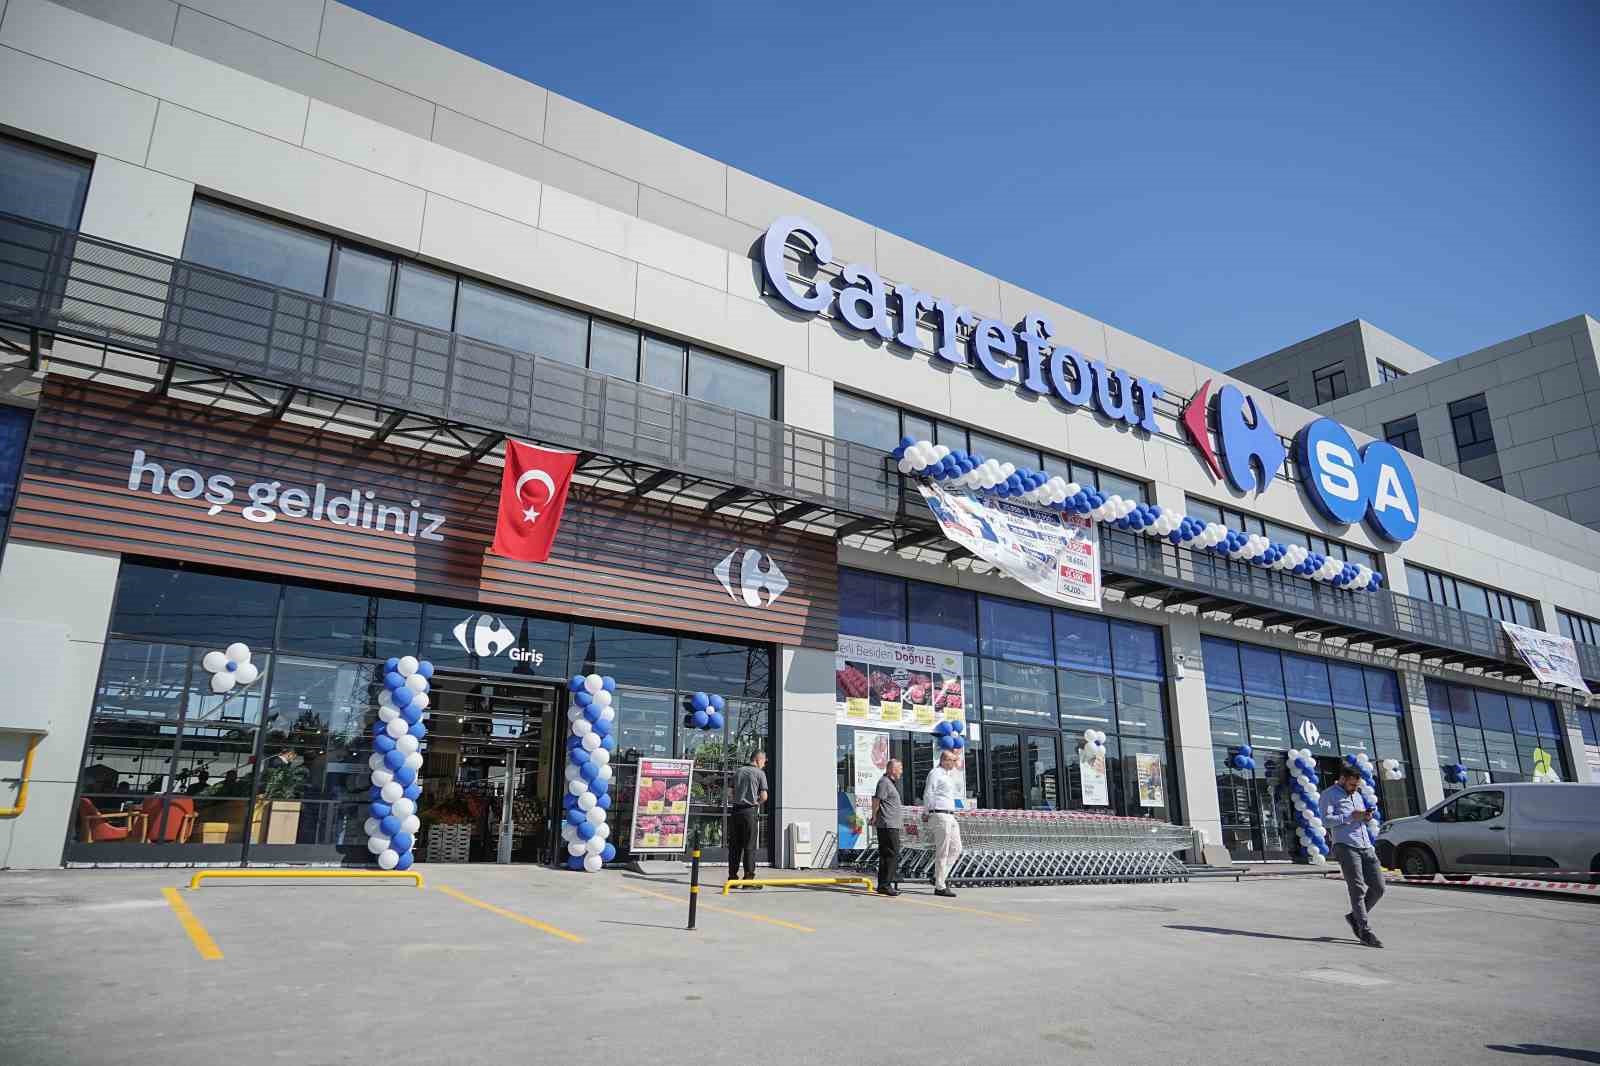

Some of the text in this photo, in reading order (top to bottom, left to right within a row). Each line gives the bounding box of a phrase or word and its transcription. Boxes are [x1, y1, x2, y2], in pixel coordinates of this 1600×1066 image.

[762, 214, 1165, 434] Carrefour
[127, 449, 447, 541] hoş geldiniz
[1315, 439, 1417, 524] SA
[508, 647, 544, 666] Giriş
[895, 649, 924, 665] Doğru
[925, 654, 936, 666] Et
